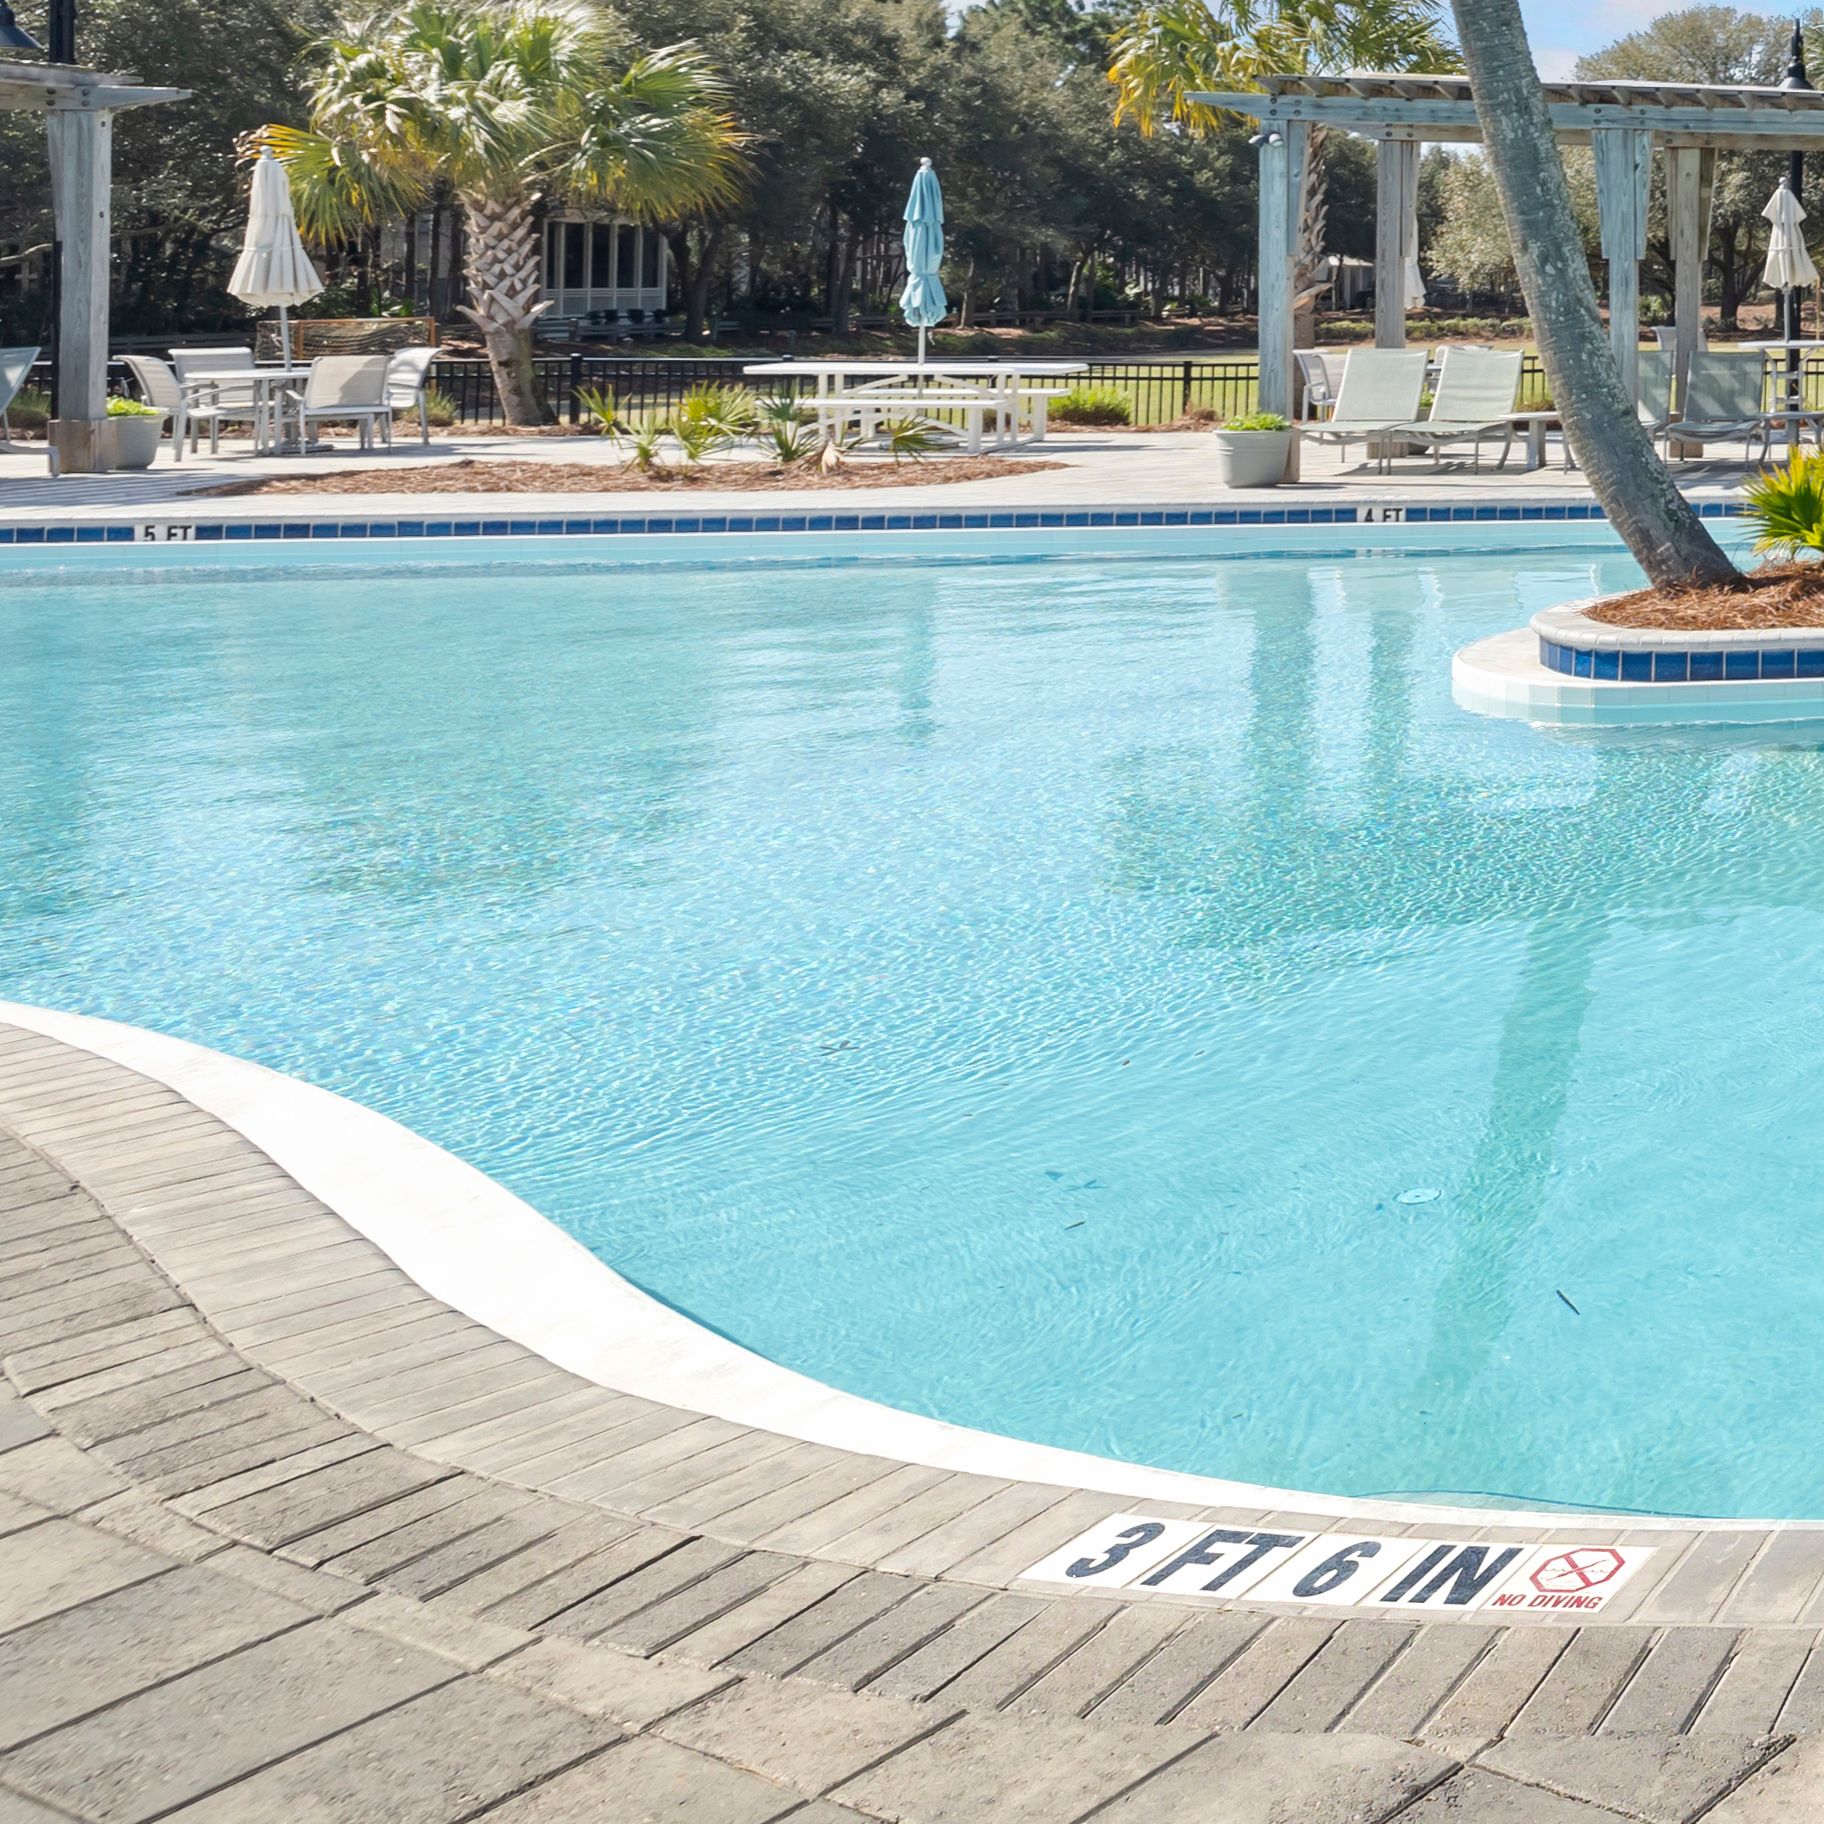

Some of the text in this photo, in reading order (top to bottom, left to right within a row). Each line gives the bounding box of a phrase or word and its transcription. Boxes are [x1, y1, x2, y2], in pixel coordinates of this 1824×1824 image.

[1364, 507, 1404, 523] 4 FT
[144, 524, 192, 542] 5 FT
[1065, 1522, 1525, 1606] 3 FT 6 IN
[1491, 1593, 1603, 1609] NO DIVING
